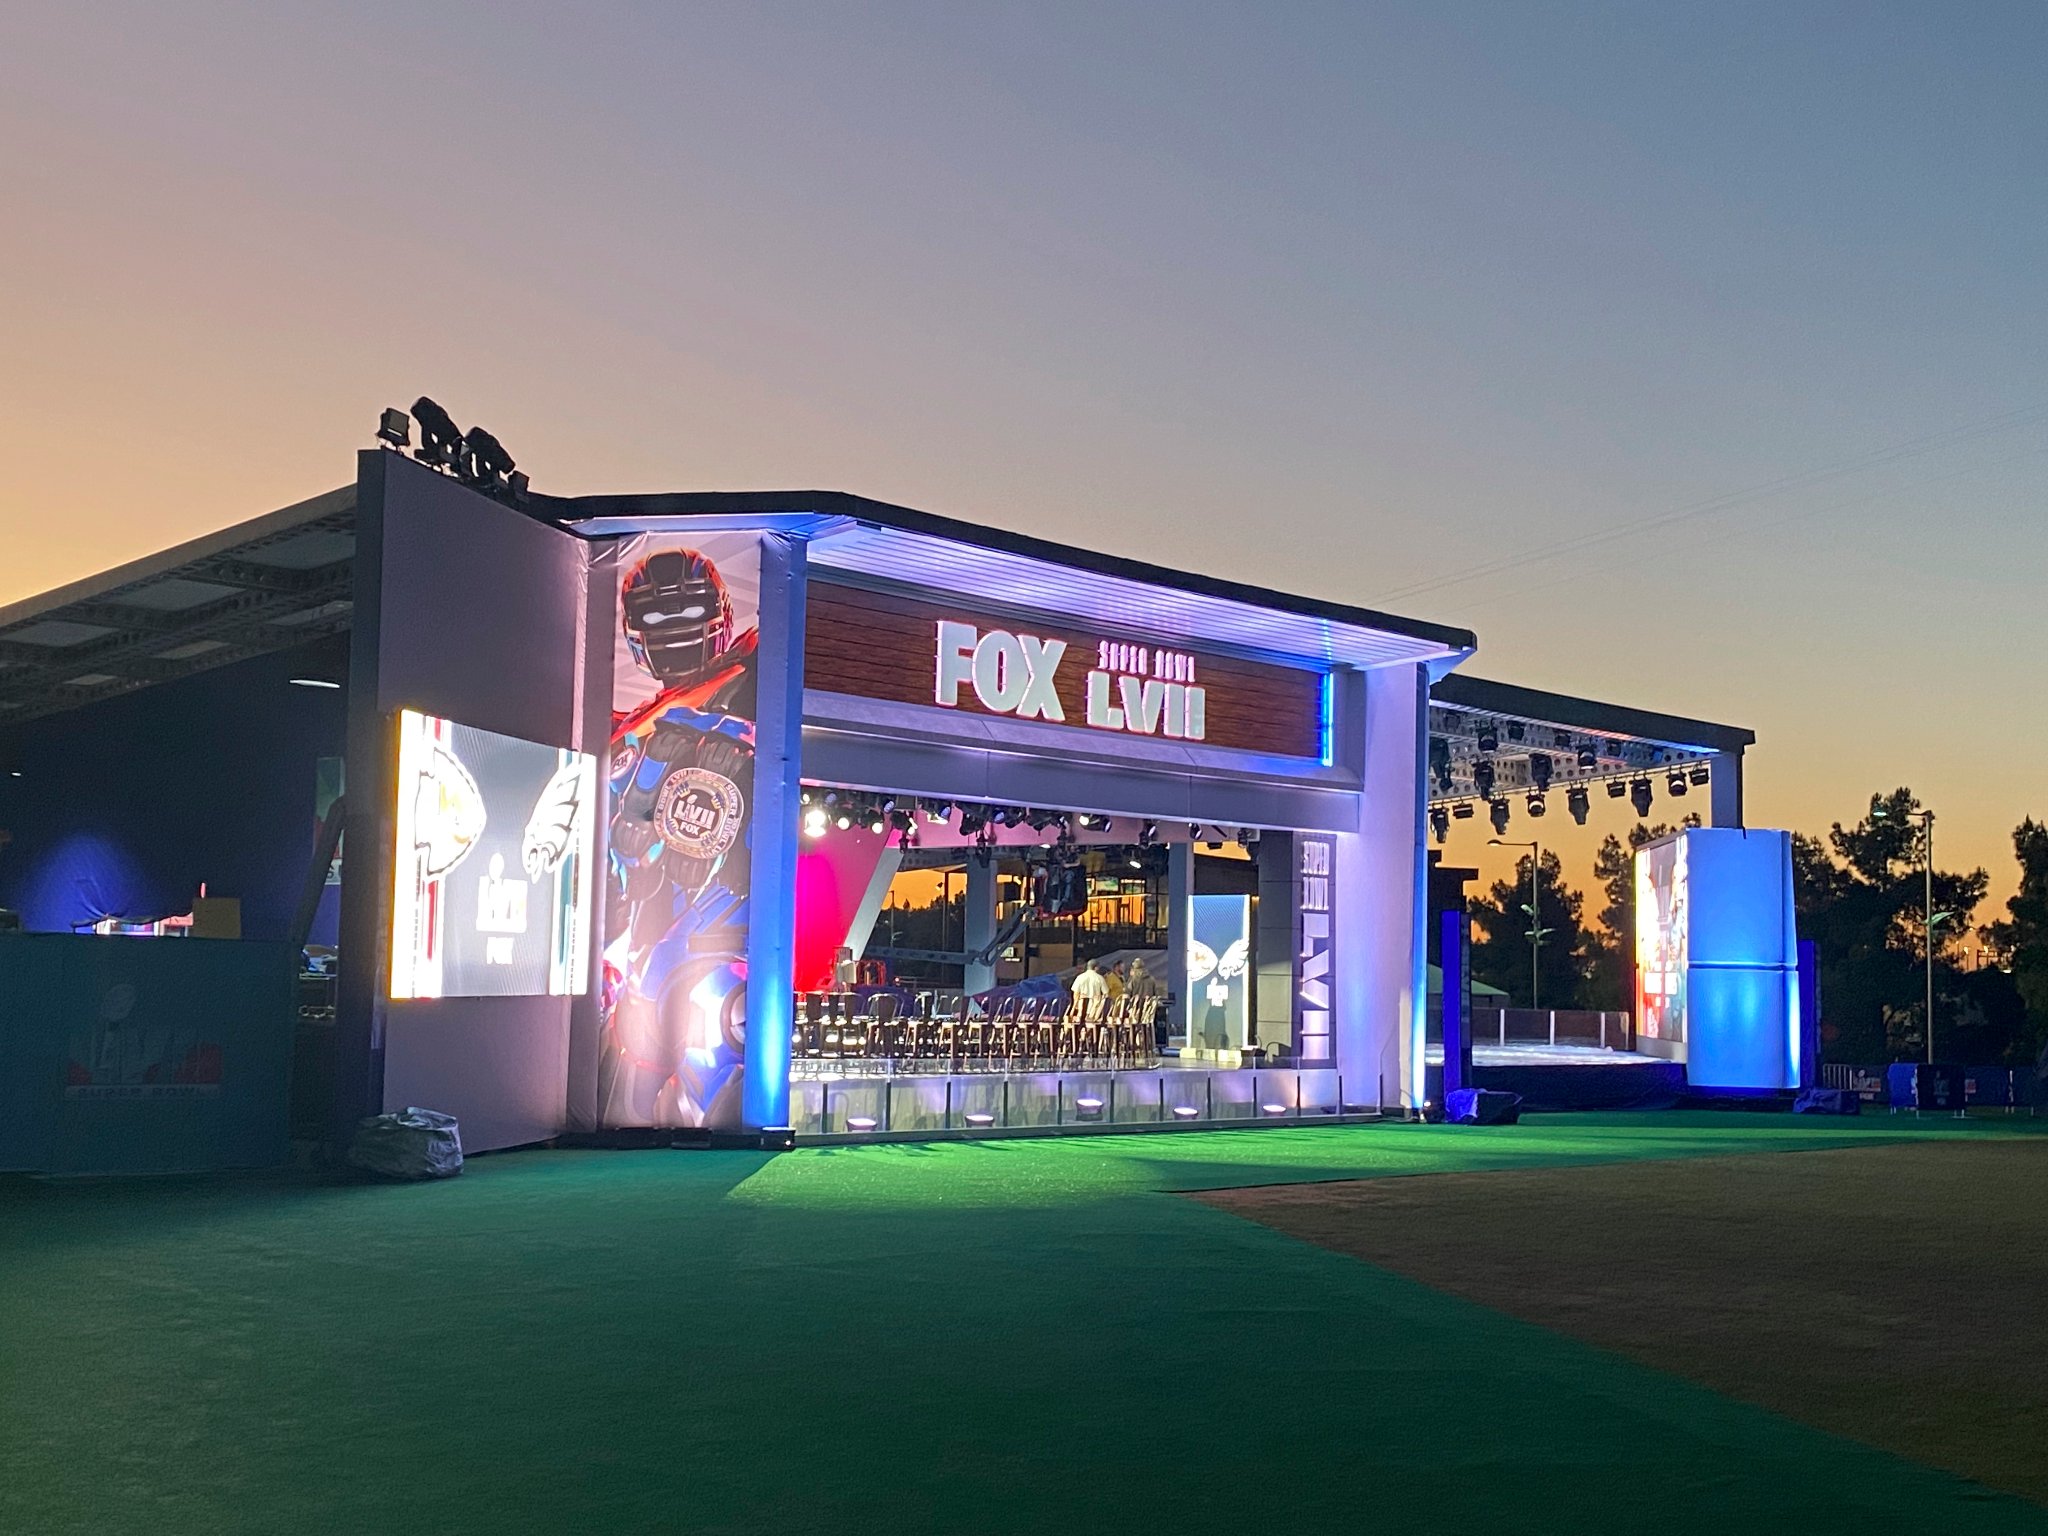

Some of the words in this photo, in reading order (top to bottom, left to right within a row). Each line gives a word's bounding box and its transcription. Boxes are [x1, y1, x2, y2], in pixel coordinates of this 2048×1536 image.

[935, 620, 1067, 722] FOX
[1087, 671, 1205, 740] LVII
[674, 799, 716, 829] LVII
[680, 821, 700, 835] FOX
[1300, 913, 1330, 1060] LVII
